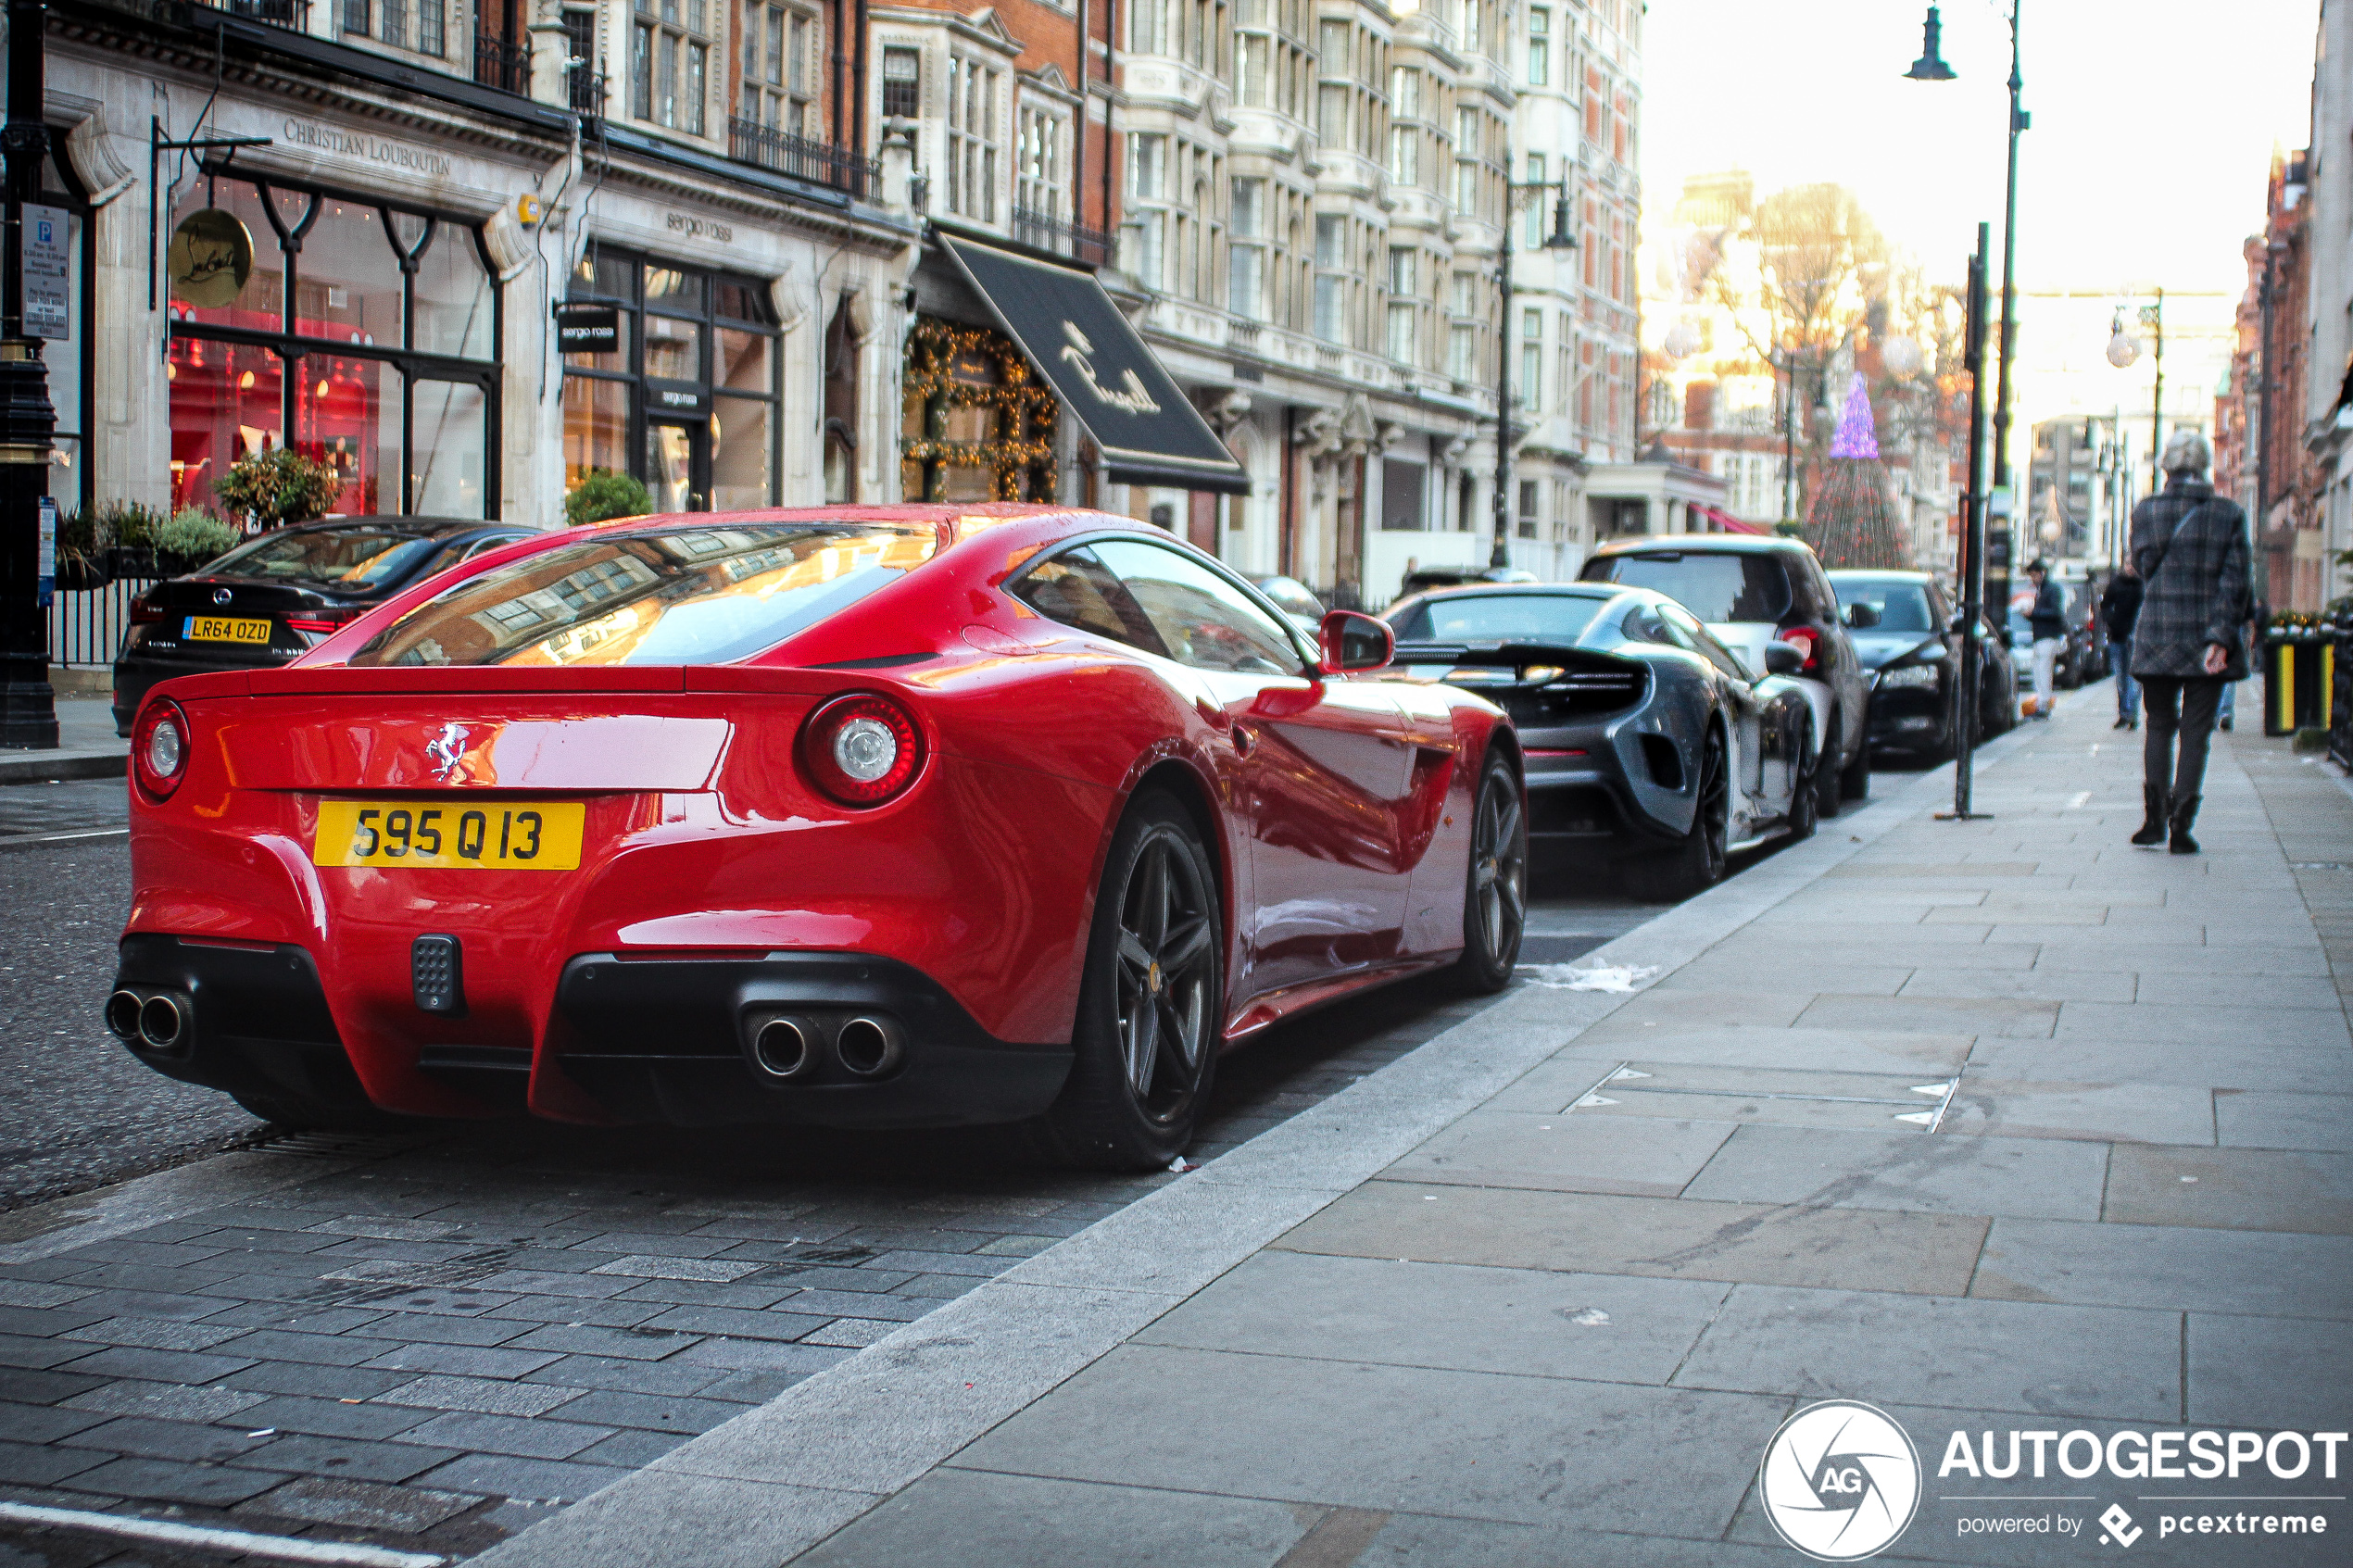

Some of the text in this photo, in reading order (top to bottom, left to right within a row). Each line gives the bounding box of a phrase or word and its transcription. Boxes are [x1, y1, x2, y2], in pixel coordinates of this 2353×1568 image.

[283, 118, 451, 175] CHRISTIAN LOUBOUTIN
[41, 223, 51, 240] P
[705, 222, 733, 242] rossi
[592, 326, 614, 338] rossi
[191, 618, 269, 641] LR64 OZD
[354, 809, 544, 860] 595 Q 13
